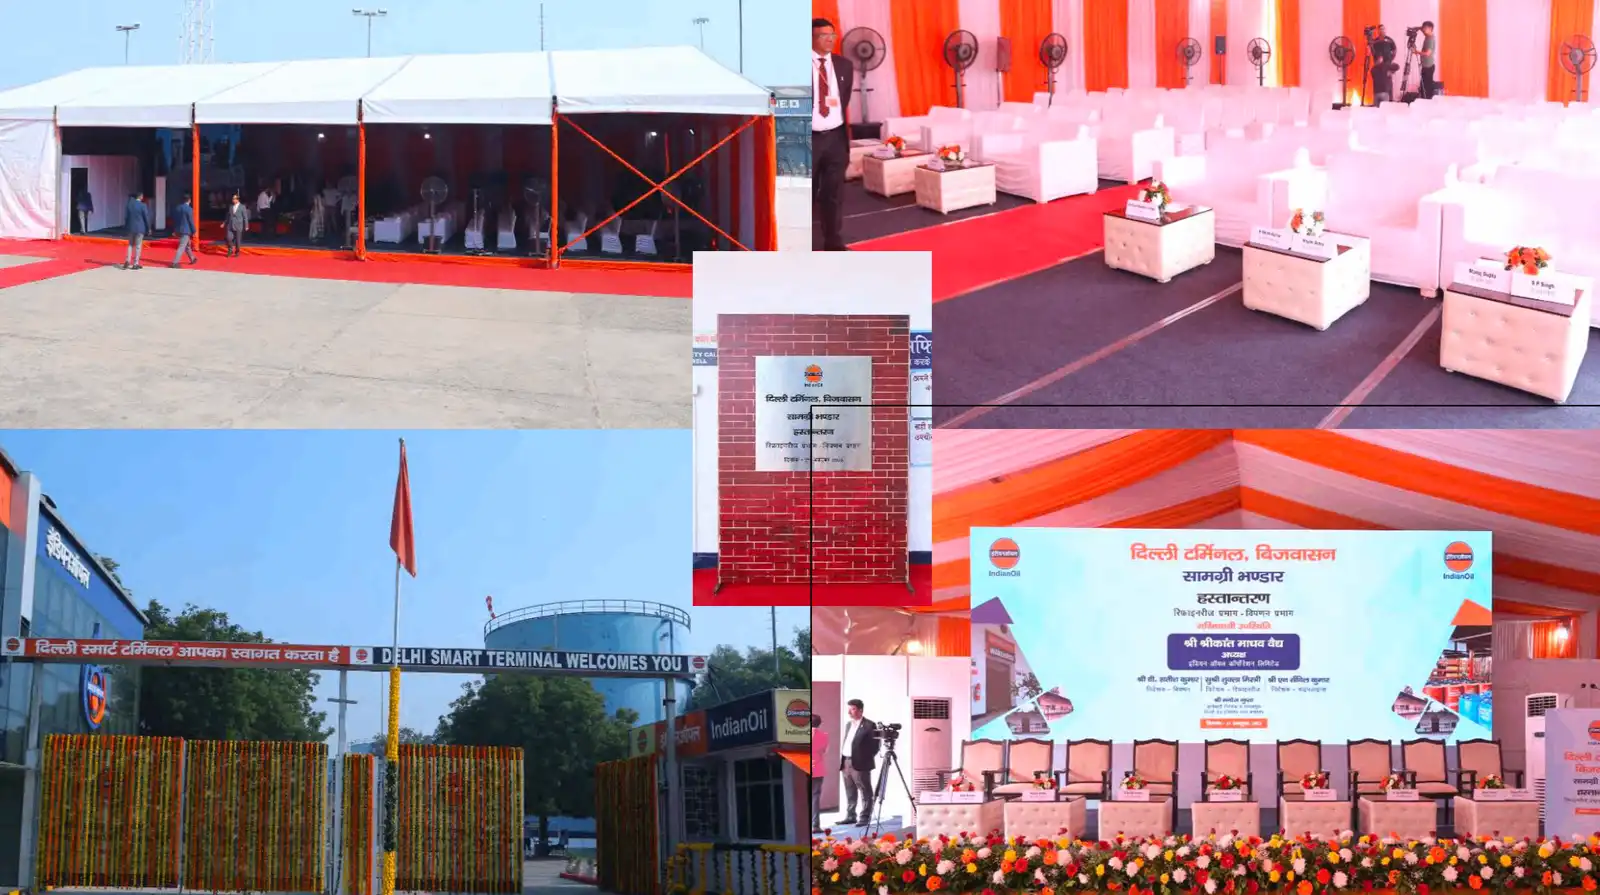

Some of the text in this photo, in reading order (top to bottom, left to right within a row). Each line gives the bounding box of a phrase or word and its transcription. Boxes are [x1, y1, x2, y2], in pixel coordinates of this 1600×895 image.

[765, 394, 788, 402] दिल्ली
[1130, 543, 1337, 562] दिल्ली टर्मिनल, बिजवासन
[1182, 566, 1285, 584] सामग्री भण्डार
[1197, 592, 1271, 605] हस्तान्तरण
[34, 639, 340, 663] दिल्ली स्मार्ट टर्मिनल आपका स्वागत करता है
[1184, 636, 1198, 648] श्री
[1200, 636, 1235, 648] श्रीकांत
[382, 648, 682, 672] DELHI SMART TERMINAL WELCOMES YOU
[711, 708, 768, 740] IndianOil
